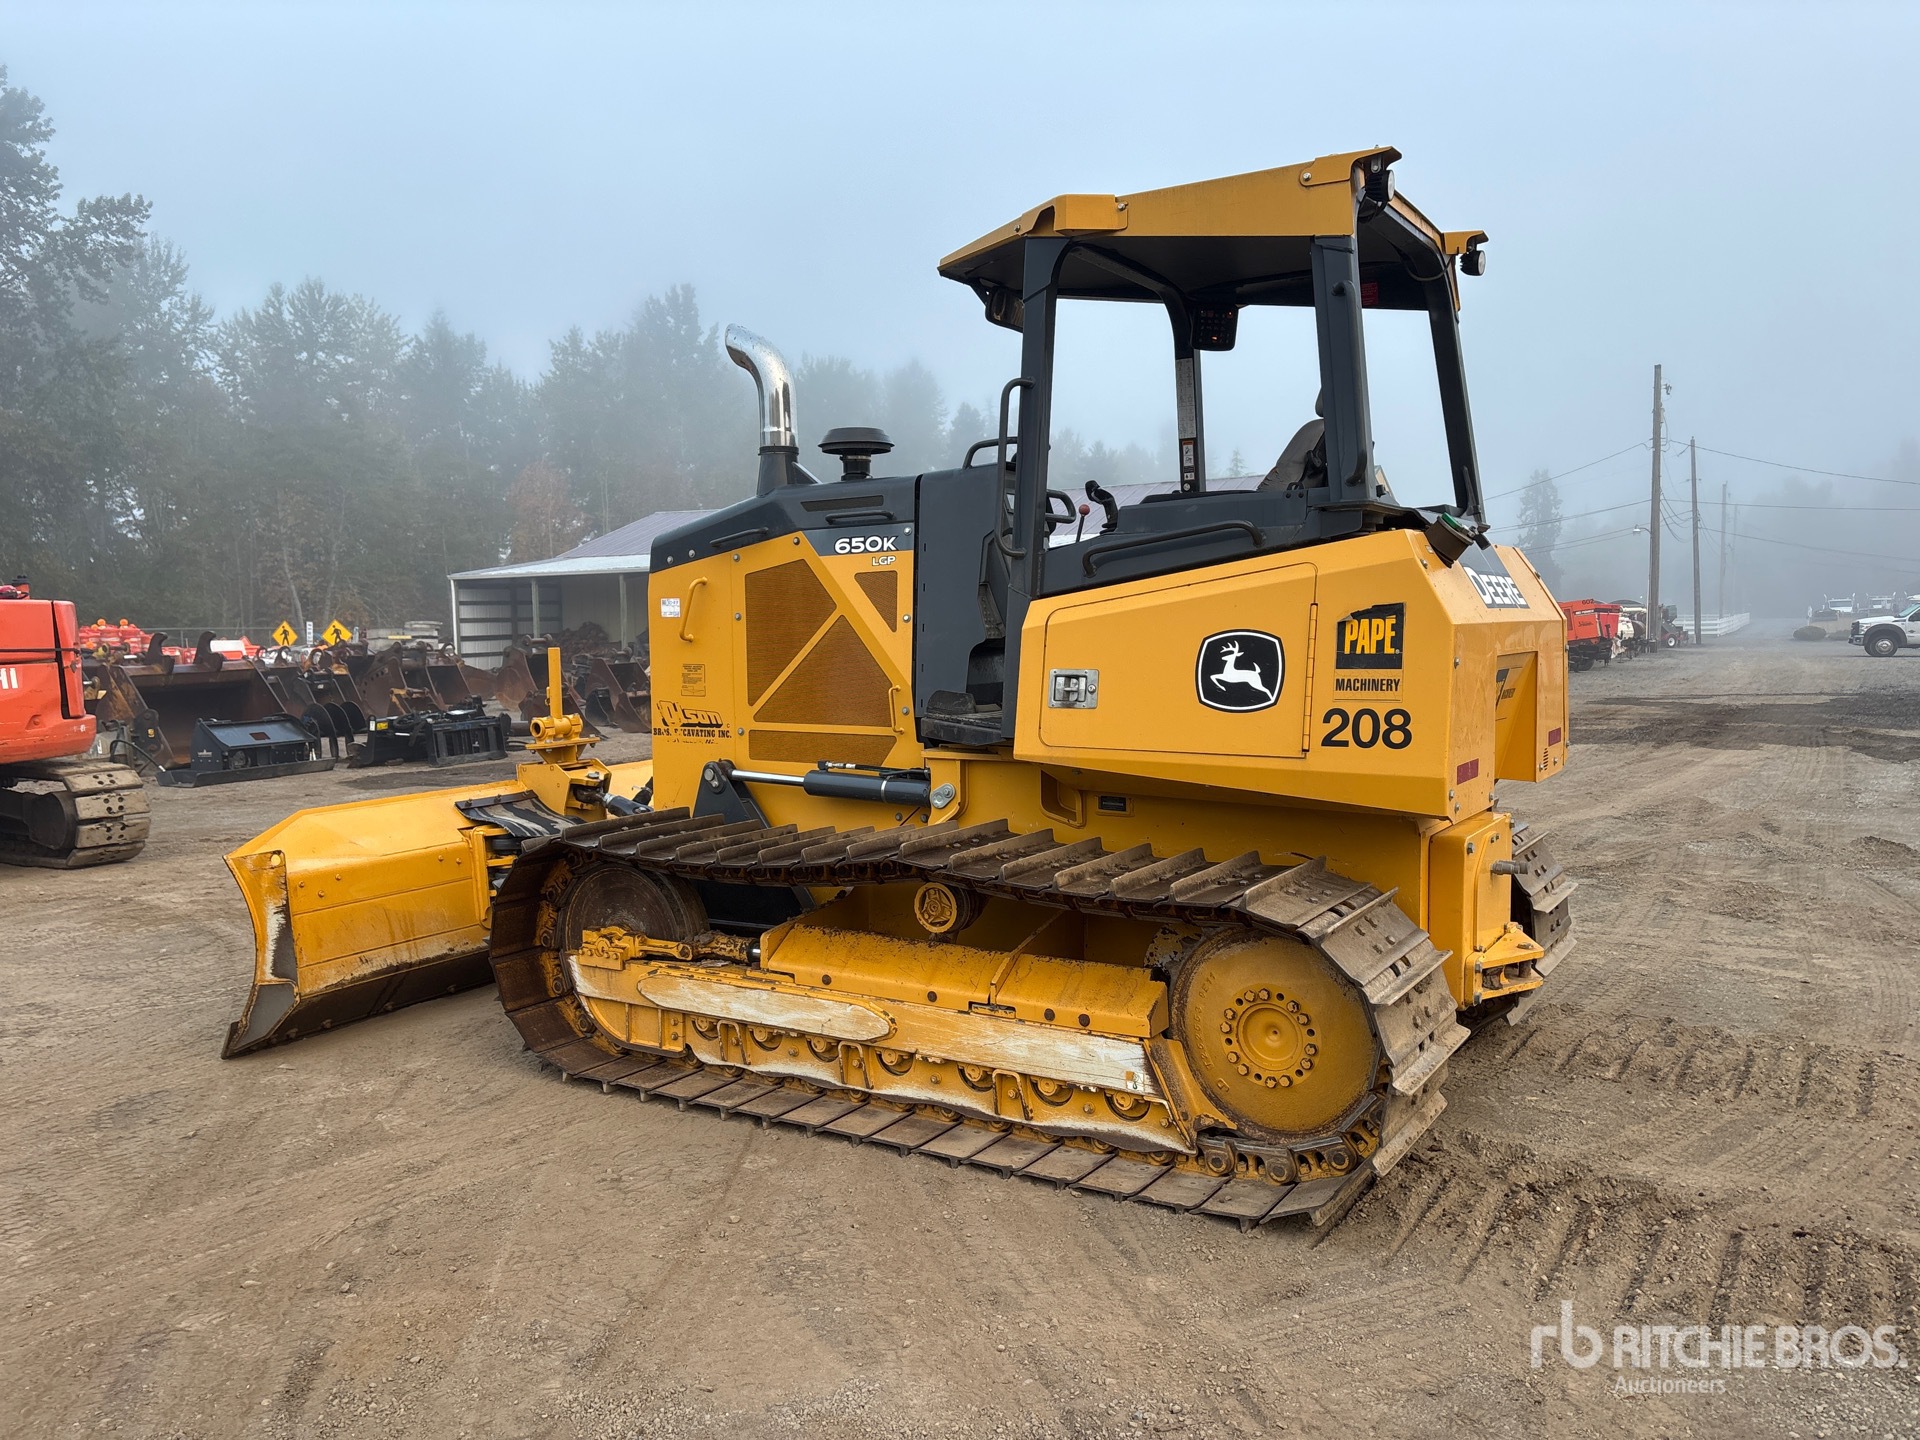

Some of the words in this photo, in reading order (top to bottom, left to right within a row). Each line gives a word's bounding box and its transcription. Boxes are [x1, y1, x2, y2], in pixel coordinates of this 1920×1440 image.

[834, 534, 899, 555] 650K
[872, 556, 896, 566] LGP
[1462, 566, 1527, 605] DEERE
[1335, 678, 1401, 692] MACHINERY
[718, 729, 732, 738] INC.
[1321, 708, 1413, 749] 208
